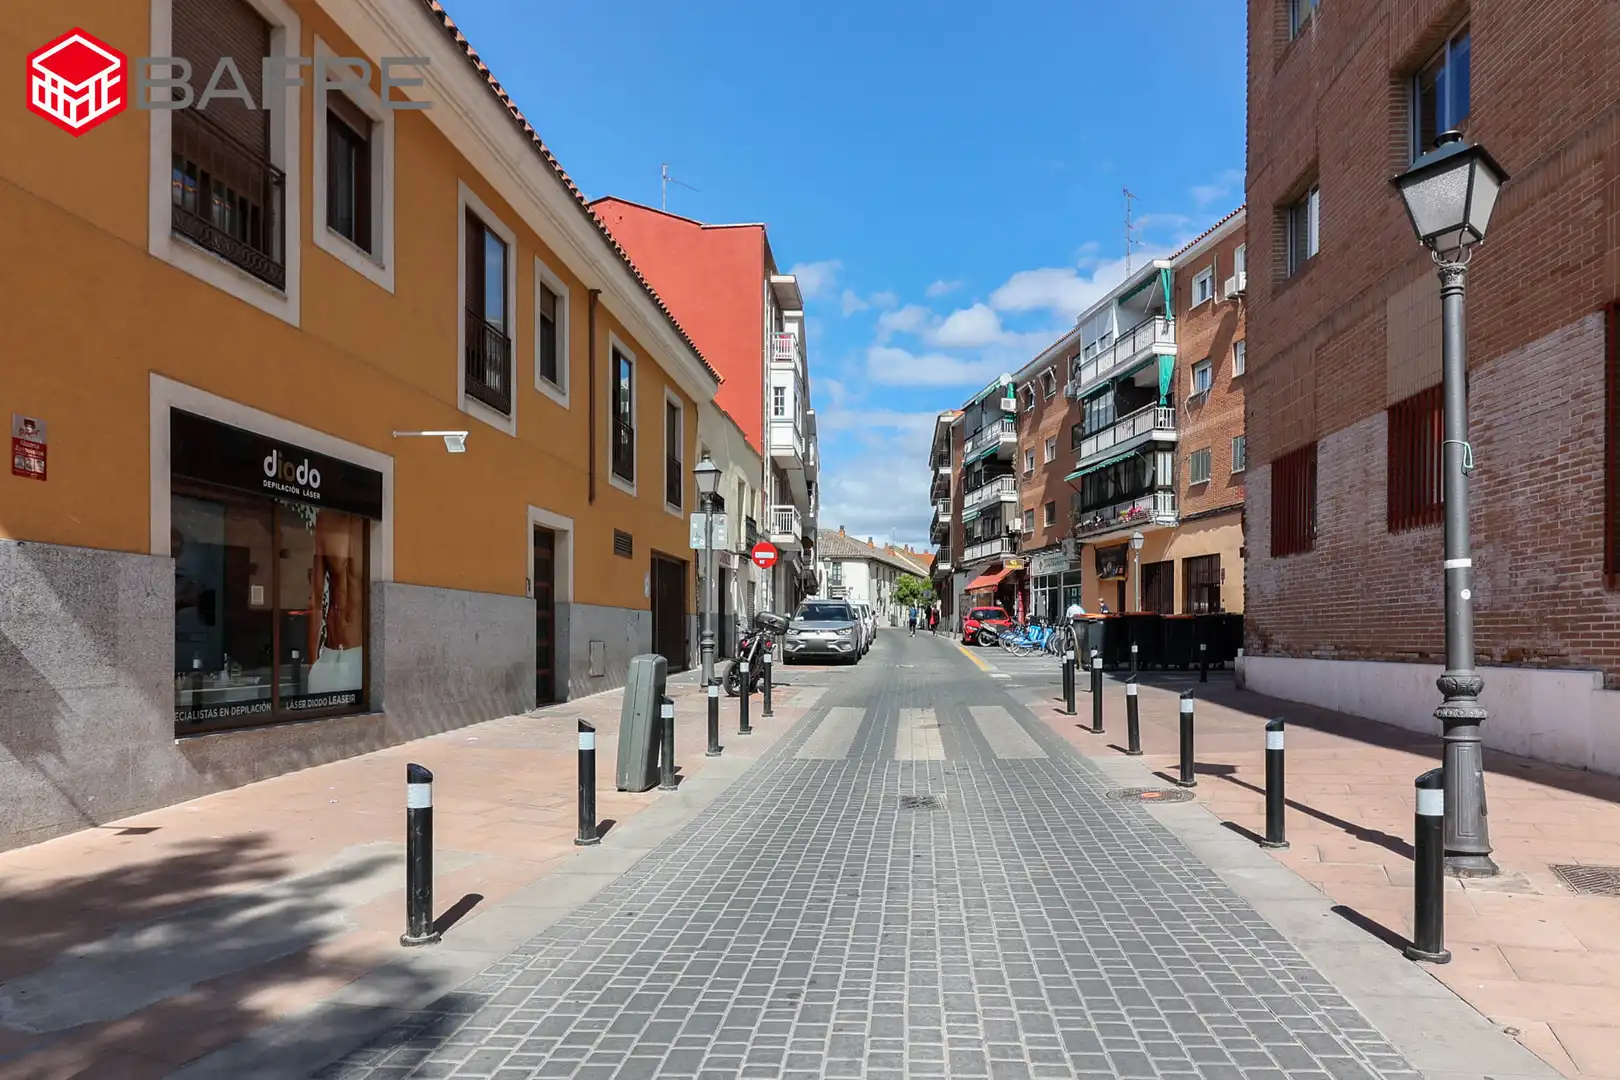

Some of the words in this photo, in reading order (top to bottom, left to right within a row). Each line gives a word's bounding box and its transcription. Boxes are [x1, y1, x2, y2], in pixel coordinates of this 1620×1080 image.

[263, 449, 321, 489] diodo
[263, 479, 300, 495] DEPILACIÓN
[219, 707, 229, 717] EN
[231, 701, 272, 716] DEPILACIÓN
[307, 697, 328, 708] DIODO
